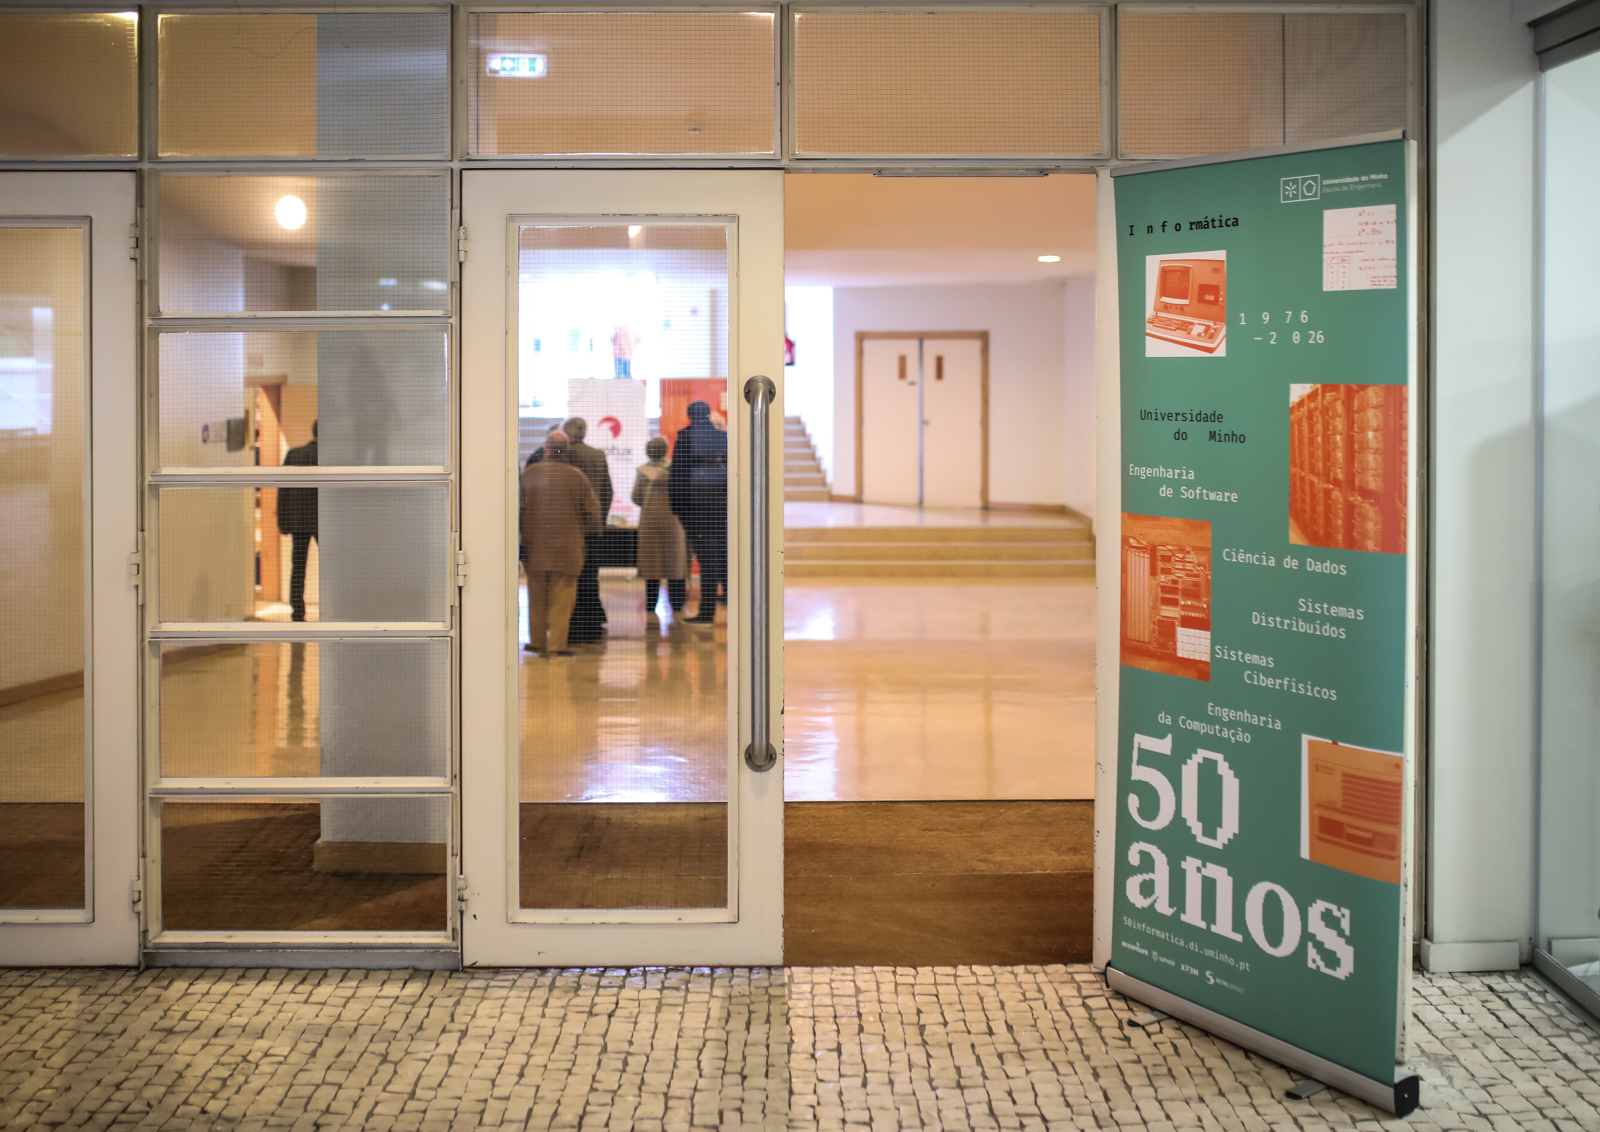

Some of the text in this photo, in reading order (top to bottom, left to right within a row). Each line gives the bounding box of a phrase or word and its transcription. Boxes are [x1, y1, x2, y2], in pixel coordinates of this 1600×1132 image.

[1322, 176, 1360, 185] Universidade
[1139, 409, 1224, 423] Universidade
[1174, 428, 1246, 444] do Minho
[1129, 464, 1195, 480] Engenharia
[1159, 485, 1238, 503] de Software
[1222, 548, 1347, 576] Ciência de Dados
[1298, 598, 1364, 621] Sistemas
[1252, 611, 1346, 639] Distribuídos
[1214, 645, 1275, 668] Sistemas
[1243, 671, 1337, 701] Ciberfísicos
[1158, 711, 1251, 743] da Computação
[1207, 702, 1282, 731] Engenharia
[1127, 732, 1240, 850] 50
[1125, 840, 1354, 981] anos
[1123, 916, 1250, 972] 50informatica.di.uminho.pt
